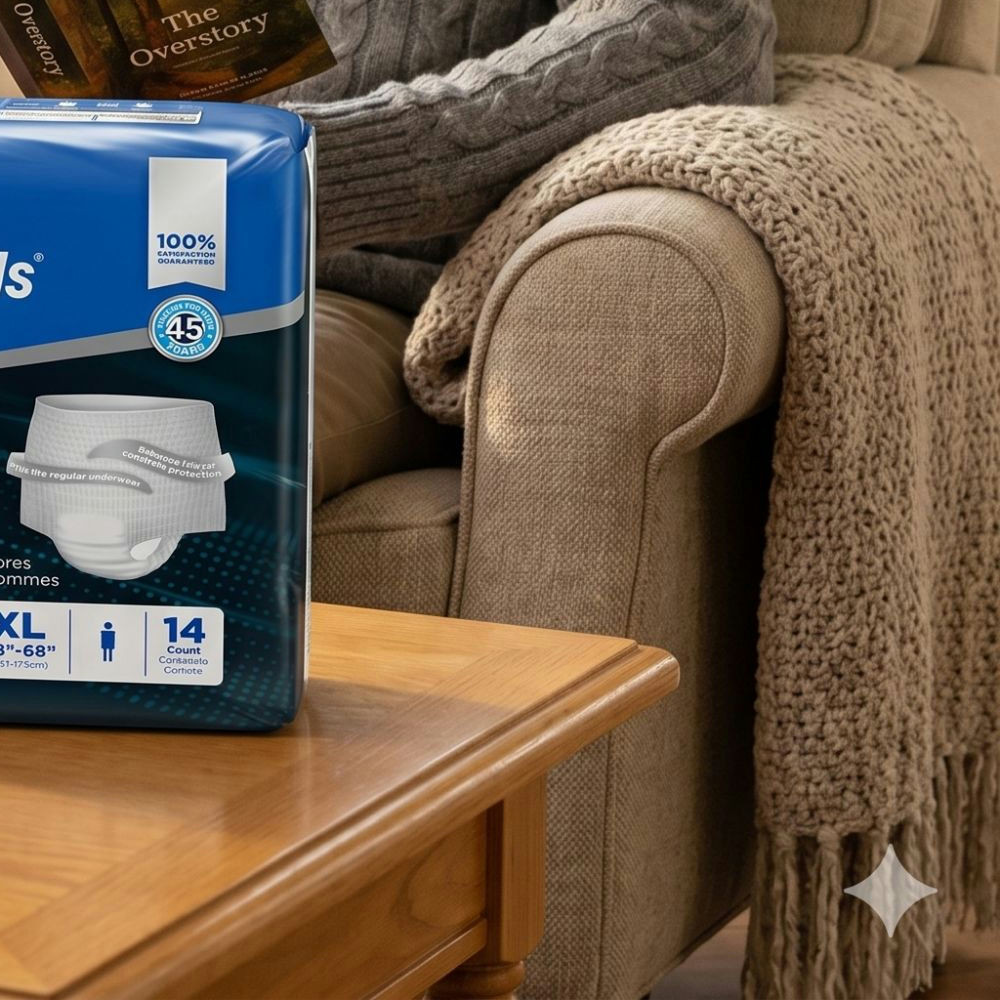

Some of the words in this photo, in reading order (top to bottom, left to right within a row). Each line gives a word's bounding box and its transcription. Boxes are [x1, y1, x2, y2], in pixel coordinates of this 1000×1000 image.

[161, 7, 220, 33] The
[14, 3, 64, 76] Overstory
[130, 12, 268, 67] Overstory
[157, 233, 216, 251] 100%
[165, 316, 204, 340] 45
[163, 616, 206, 643] 14
[167, 645, 201, 655] Count
